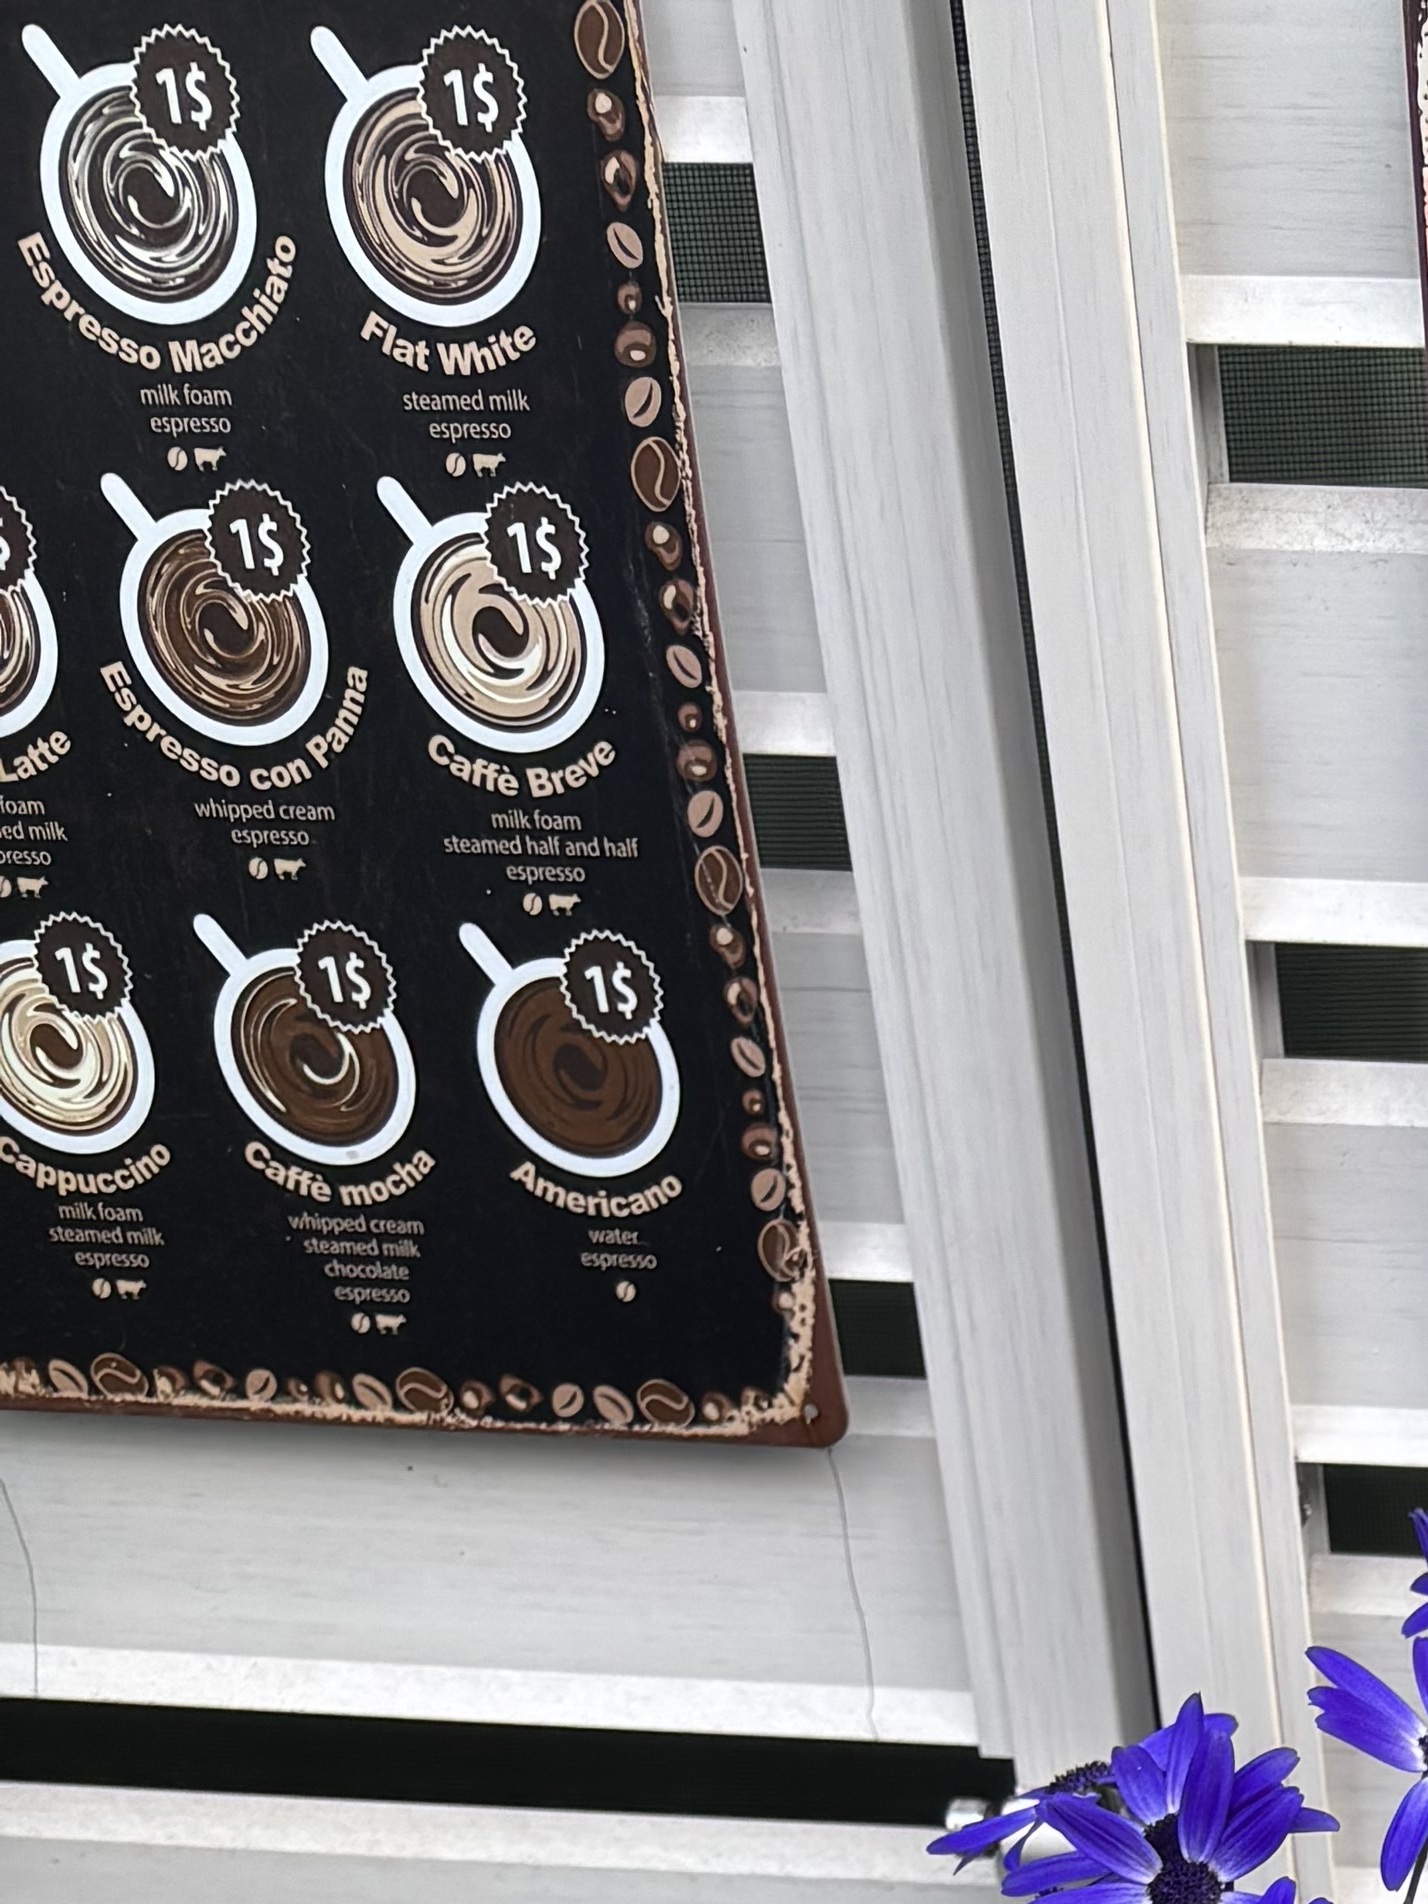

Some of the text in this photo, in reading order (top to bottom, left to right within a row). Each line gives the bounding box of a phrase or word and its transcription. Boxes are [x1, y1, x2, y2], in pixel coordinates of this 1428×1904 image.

[155, 62, 213, 132] 1$
[443, 63, 500, 133] 1$
[17, 231, 297, 374] Espresso Macchiato
[360, 310, 538, 377] Flat White
[140, 384, 233, 407] milk foam
[402, 389, 531, 412] steamed milk
[150, 415, 232, 439] espresso
[429, 421, 512, 443] espresso
[229, 513, 285, 576] 1$
[506, 516, 563, 581] 1$
[100, 660, 369, 791] Espresso con Panna
[427, 734, 617, 799] Caffè Breve
[194, 797, 336, 824] whipped cream
[491, 808, 583, 833] milk foam
[28, 820, 69, 842] milk
[231, 826, 311, 848] espresso
[443, 835, 640, 859] steamed half and half
[506, 864, 586, 886] espresso
[54, 942, 110, 1000] 1$
[317, 951, 373, 1010] 1$
[583, 961, 639, 1021] 1$
[0, 1135, 172, 1197] Cappuccino
[244, 1140, 437, 1208] Caffè mocha
[510, 1160, 684, 1219] Americano
[58, 1202, 144, 1224] milk foam
[288, 1212, 425, 1237] whipped cream
[48, 1225, 166, 1247] steamed milk
[303, 1236, 422, 1260] steamed milk
[588, 1227, 640, 1246] water
[74, 1250, 150, 1270] espresso
[324, 1260, 411, 1281] chocolate
[580, 1250, 659, 1271] espresso
[333, 1285, 411, 1306] espresso
